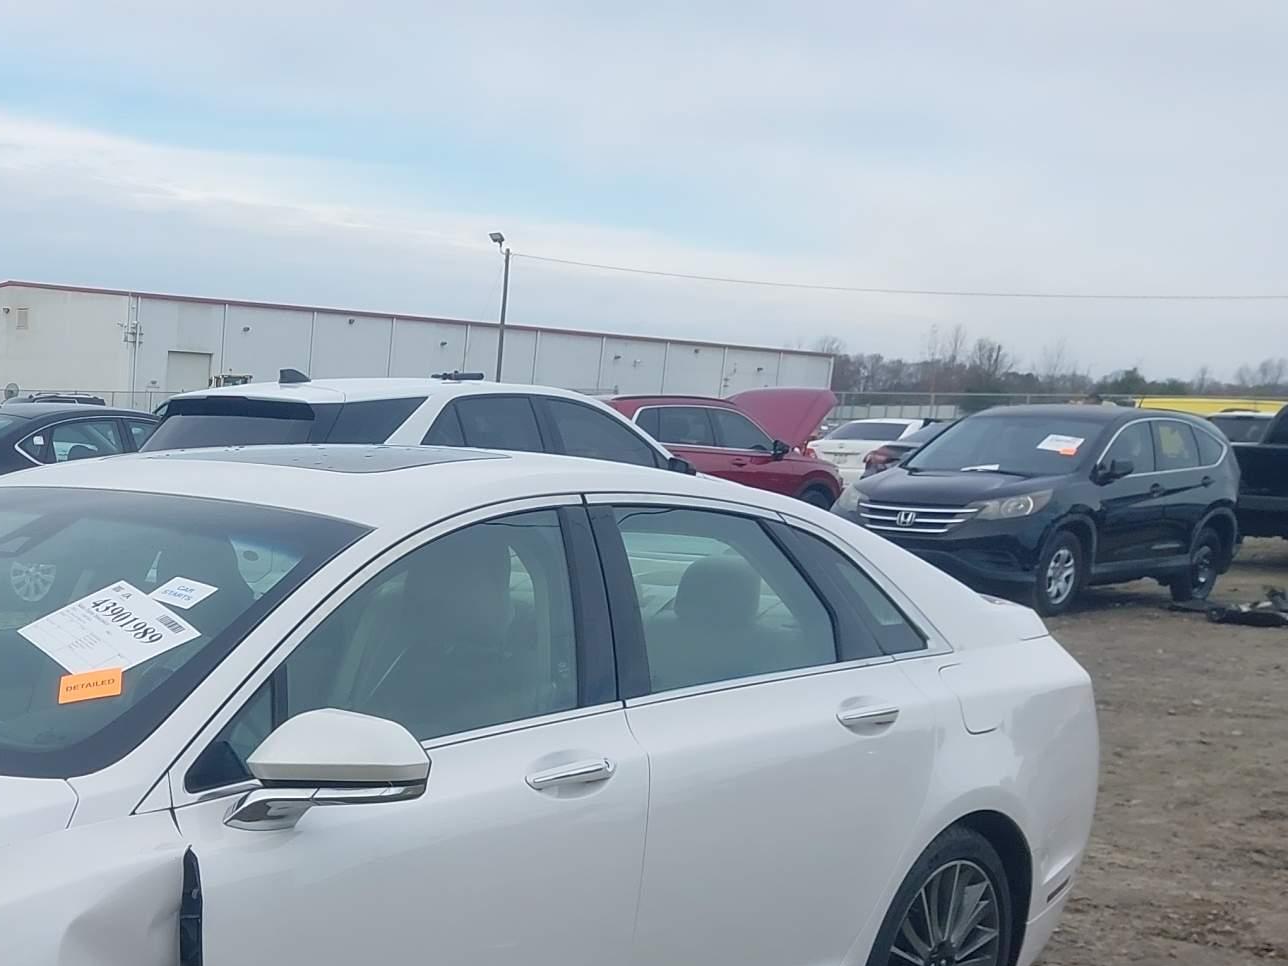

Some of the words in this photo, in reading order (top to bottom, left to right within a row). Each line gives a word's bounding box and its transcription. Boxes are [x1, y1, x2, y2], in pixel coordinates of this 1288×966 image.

[162, 589, 192, 601] STARTS
[176, 585, 194, 593] CAR
[91, 598, 163, 644] 43901989
[65, 678, 115, 692] DETAILED
